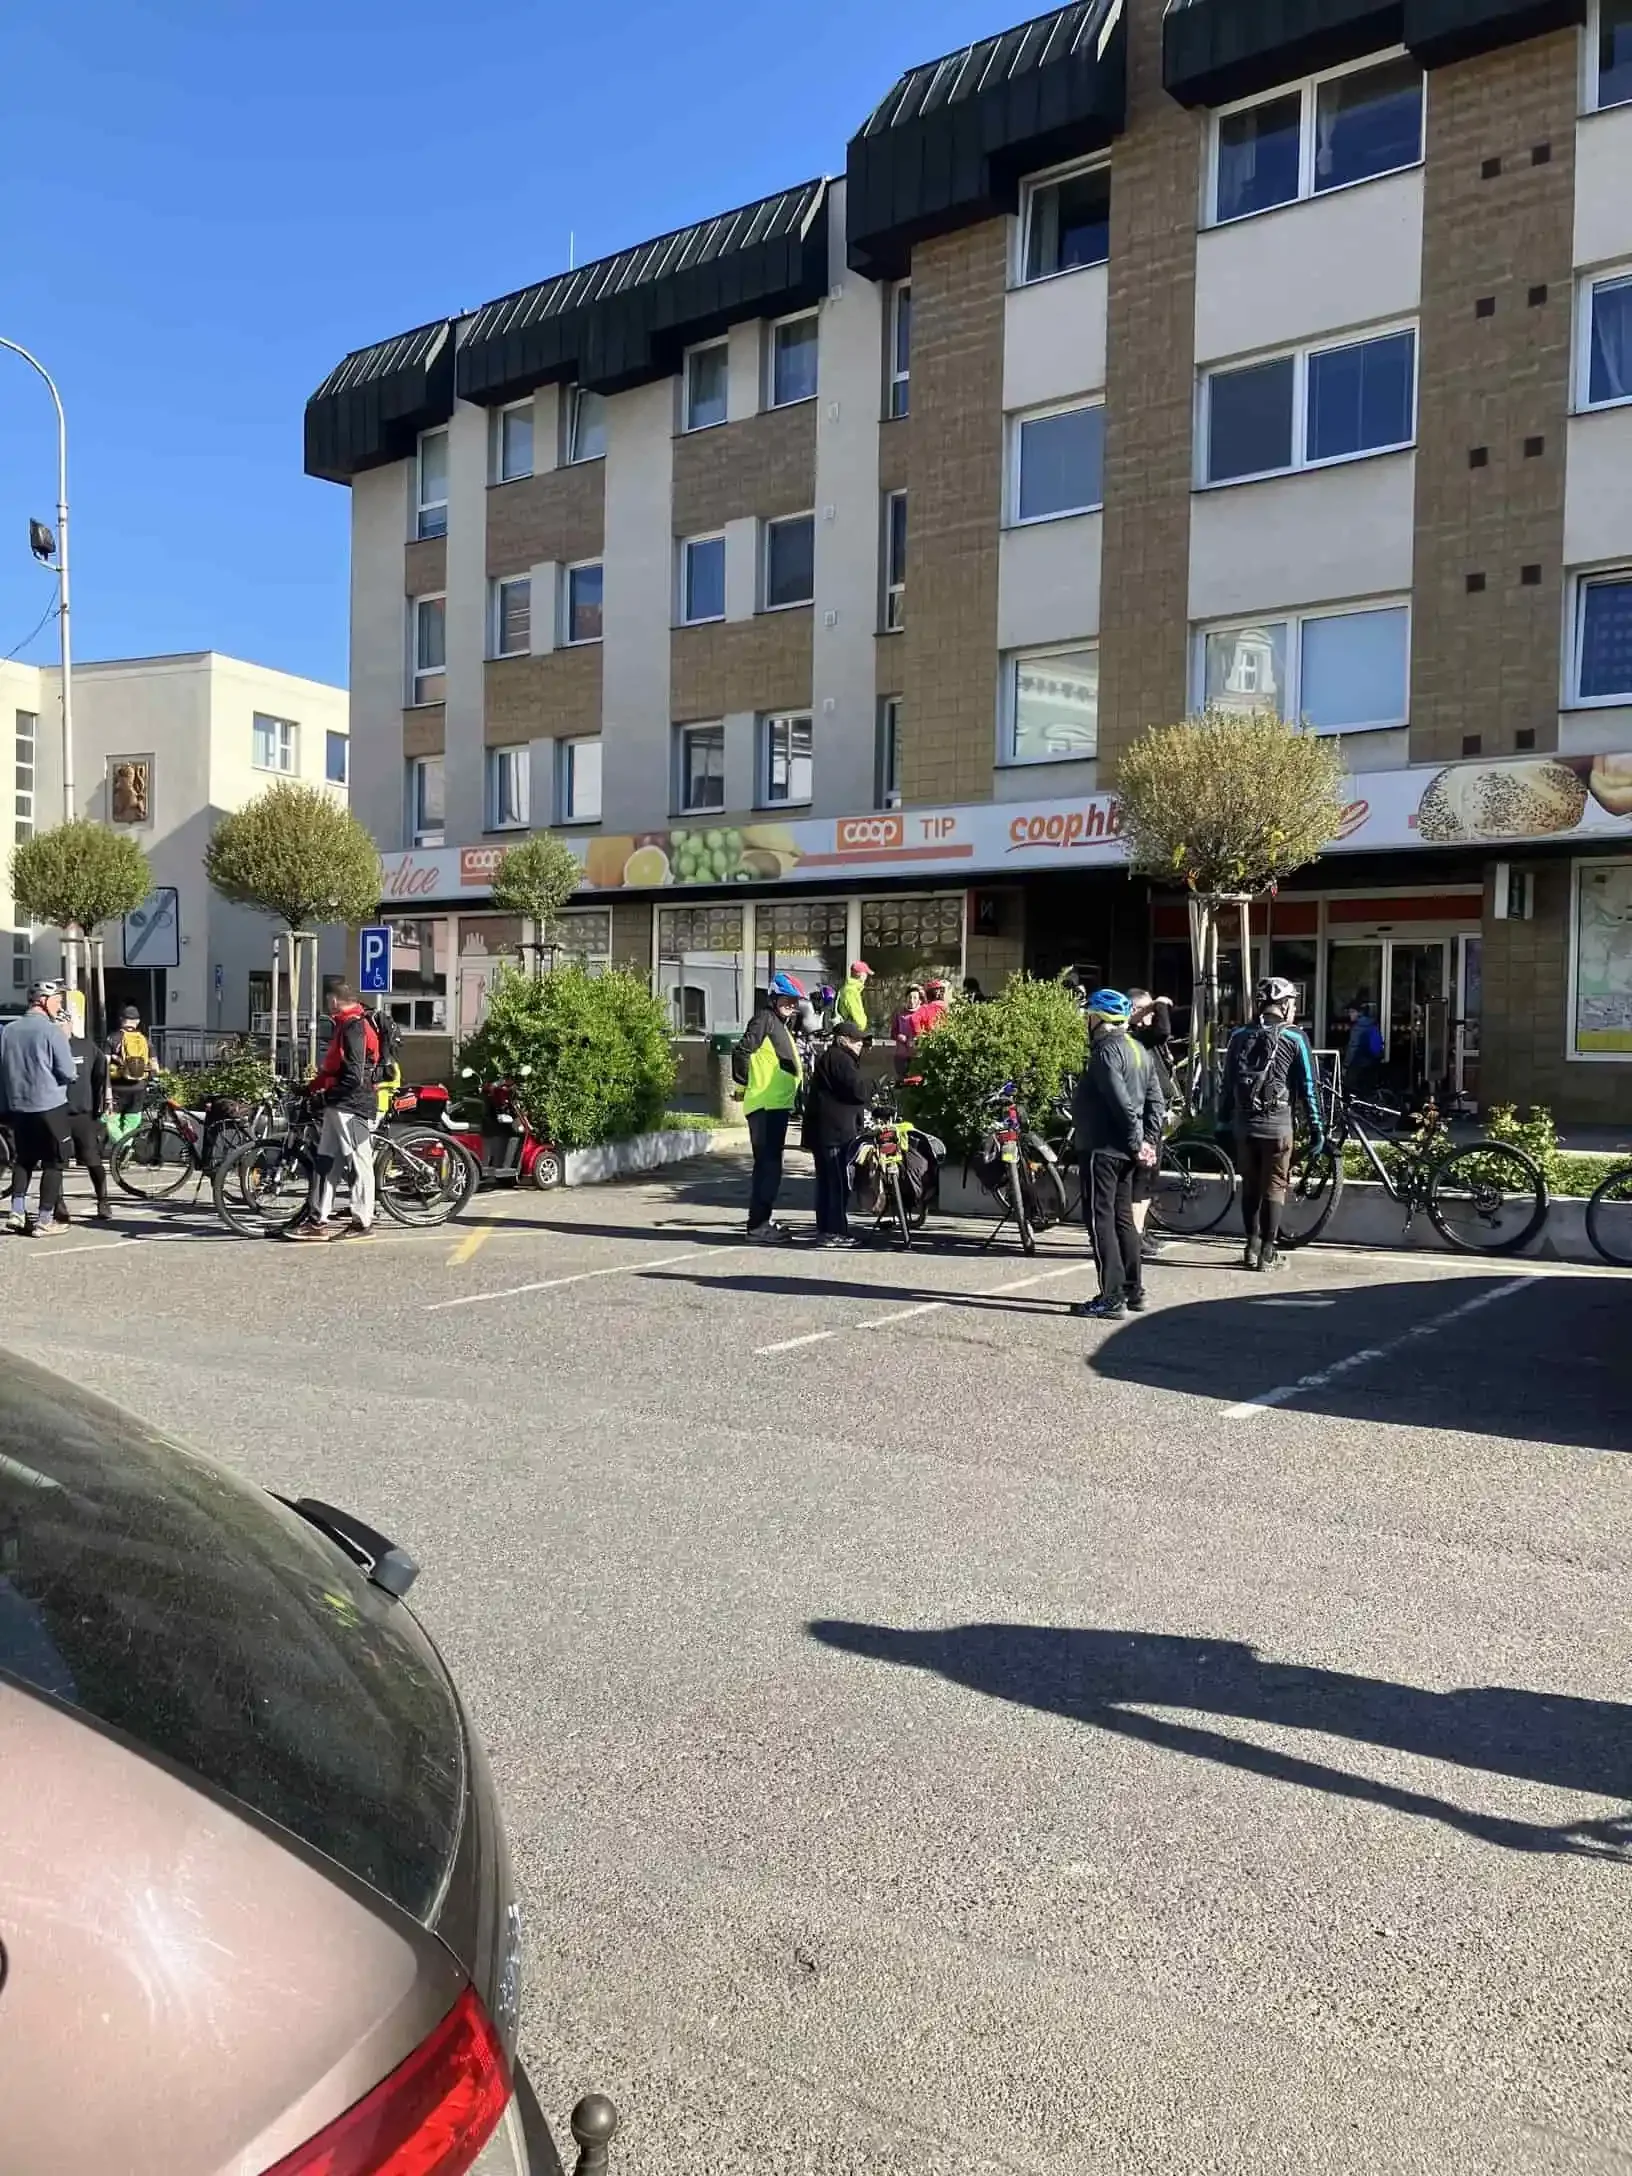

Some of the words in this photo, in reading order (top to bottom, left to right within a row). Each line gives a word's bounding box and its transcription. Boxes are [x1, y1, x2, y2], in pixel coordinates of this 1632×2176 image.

[843, 820, 898, 846] coop
[919, 816, 956, 840] TIP
[380, 853, 440, 897] rlice
[366, 935, 384, 973] P
